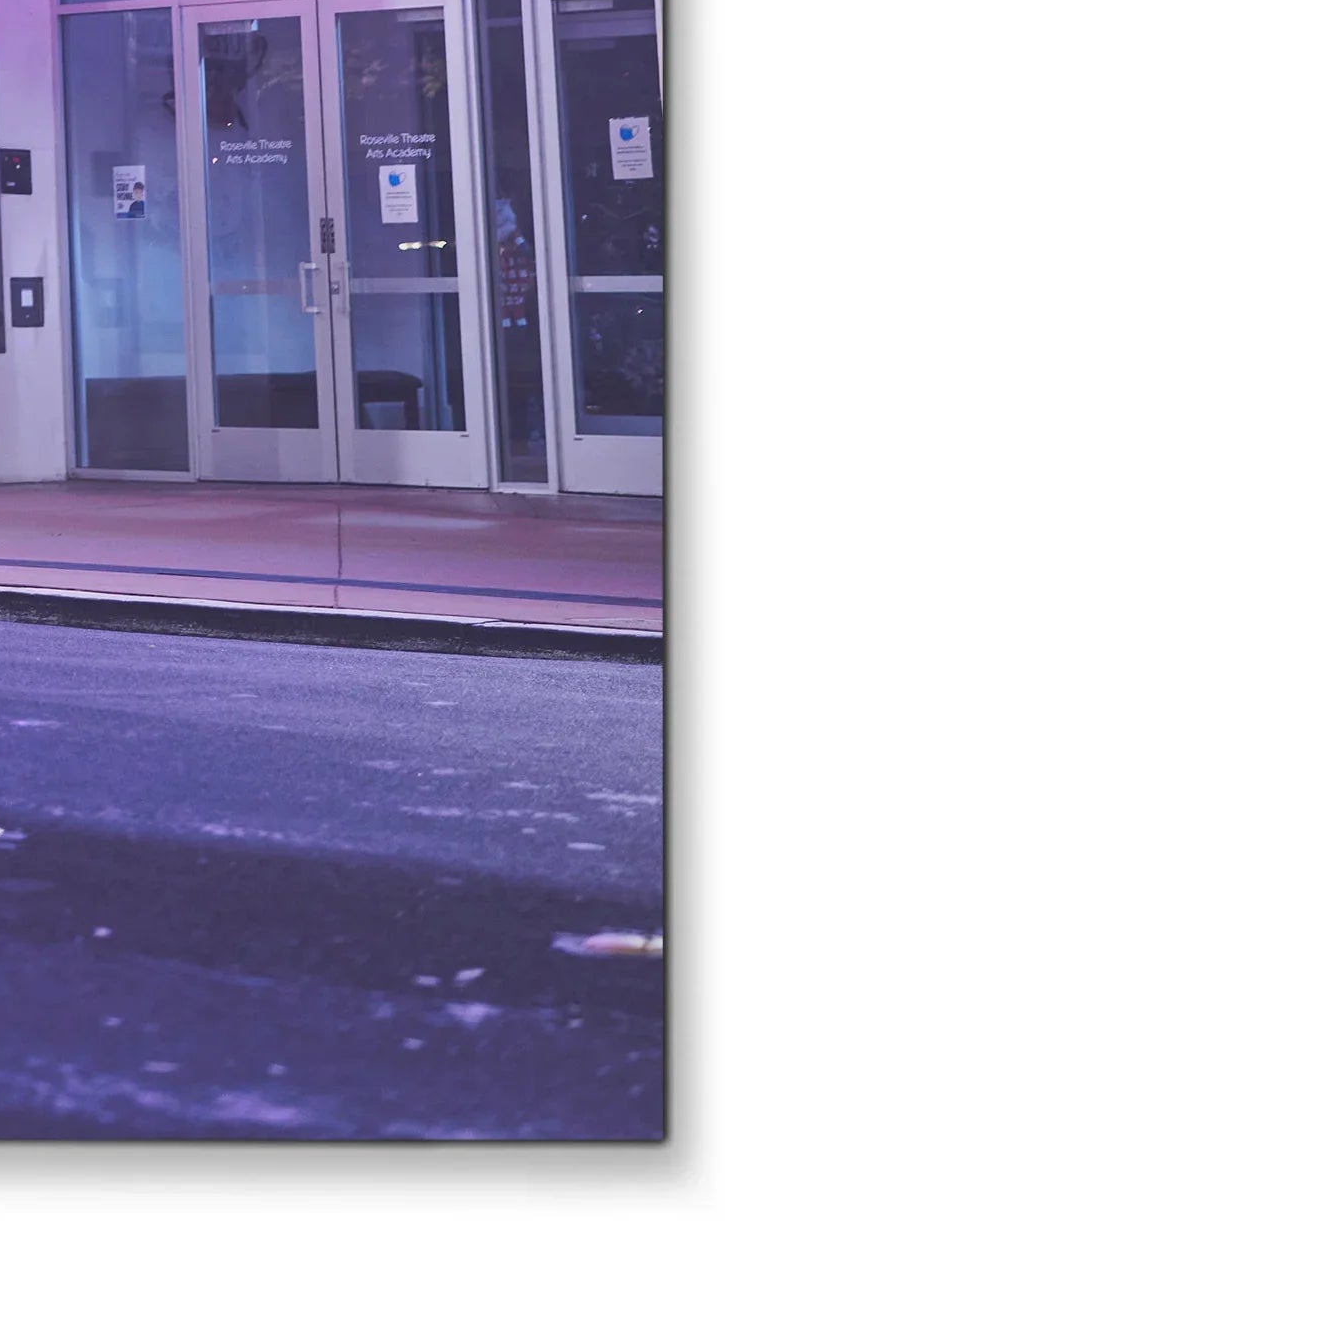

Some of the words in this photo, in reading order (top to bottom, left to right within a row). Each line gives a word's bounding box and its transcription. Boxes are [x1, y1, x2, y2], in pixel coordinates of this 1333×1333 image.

[220, 140, 258, 151] Roseville
[259, 139, 293, 150] Theatre
[359, 134, 399, 146] Roseville
[400, 132, 437, 144] Theatre
[244, 153, 288, 165] Academy
[365, 148, 384, 159] Arts
[385, 147, 432, 159] Academy
